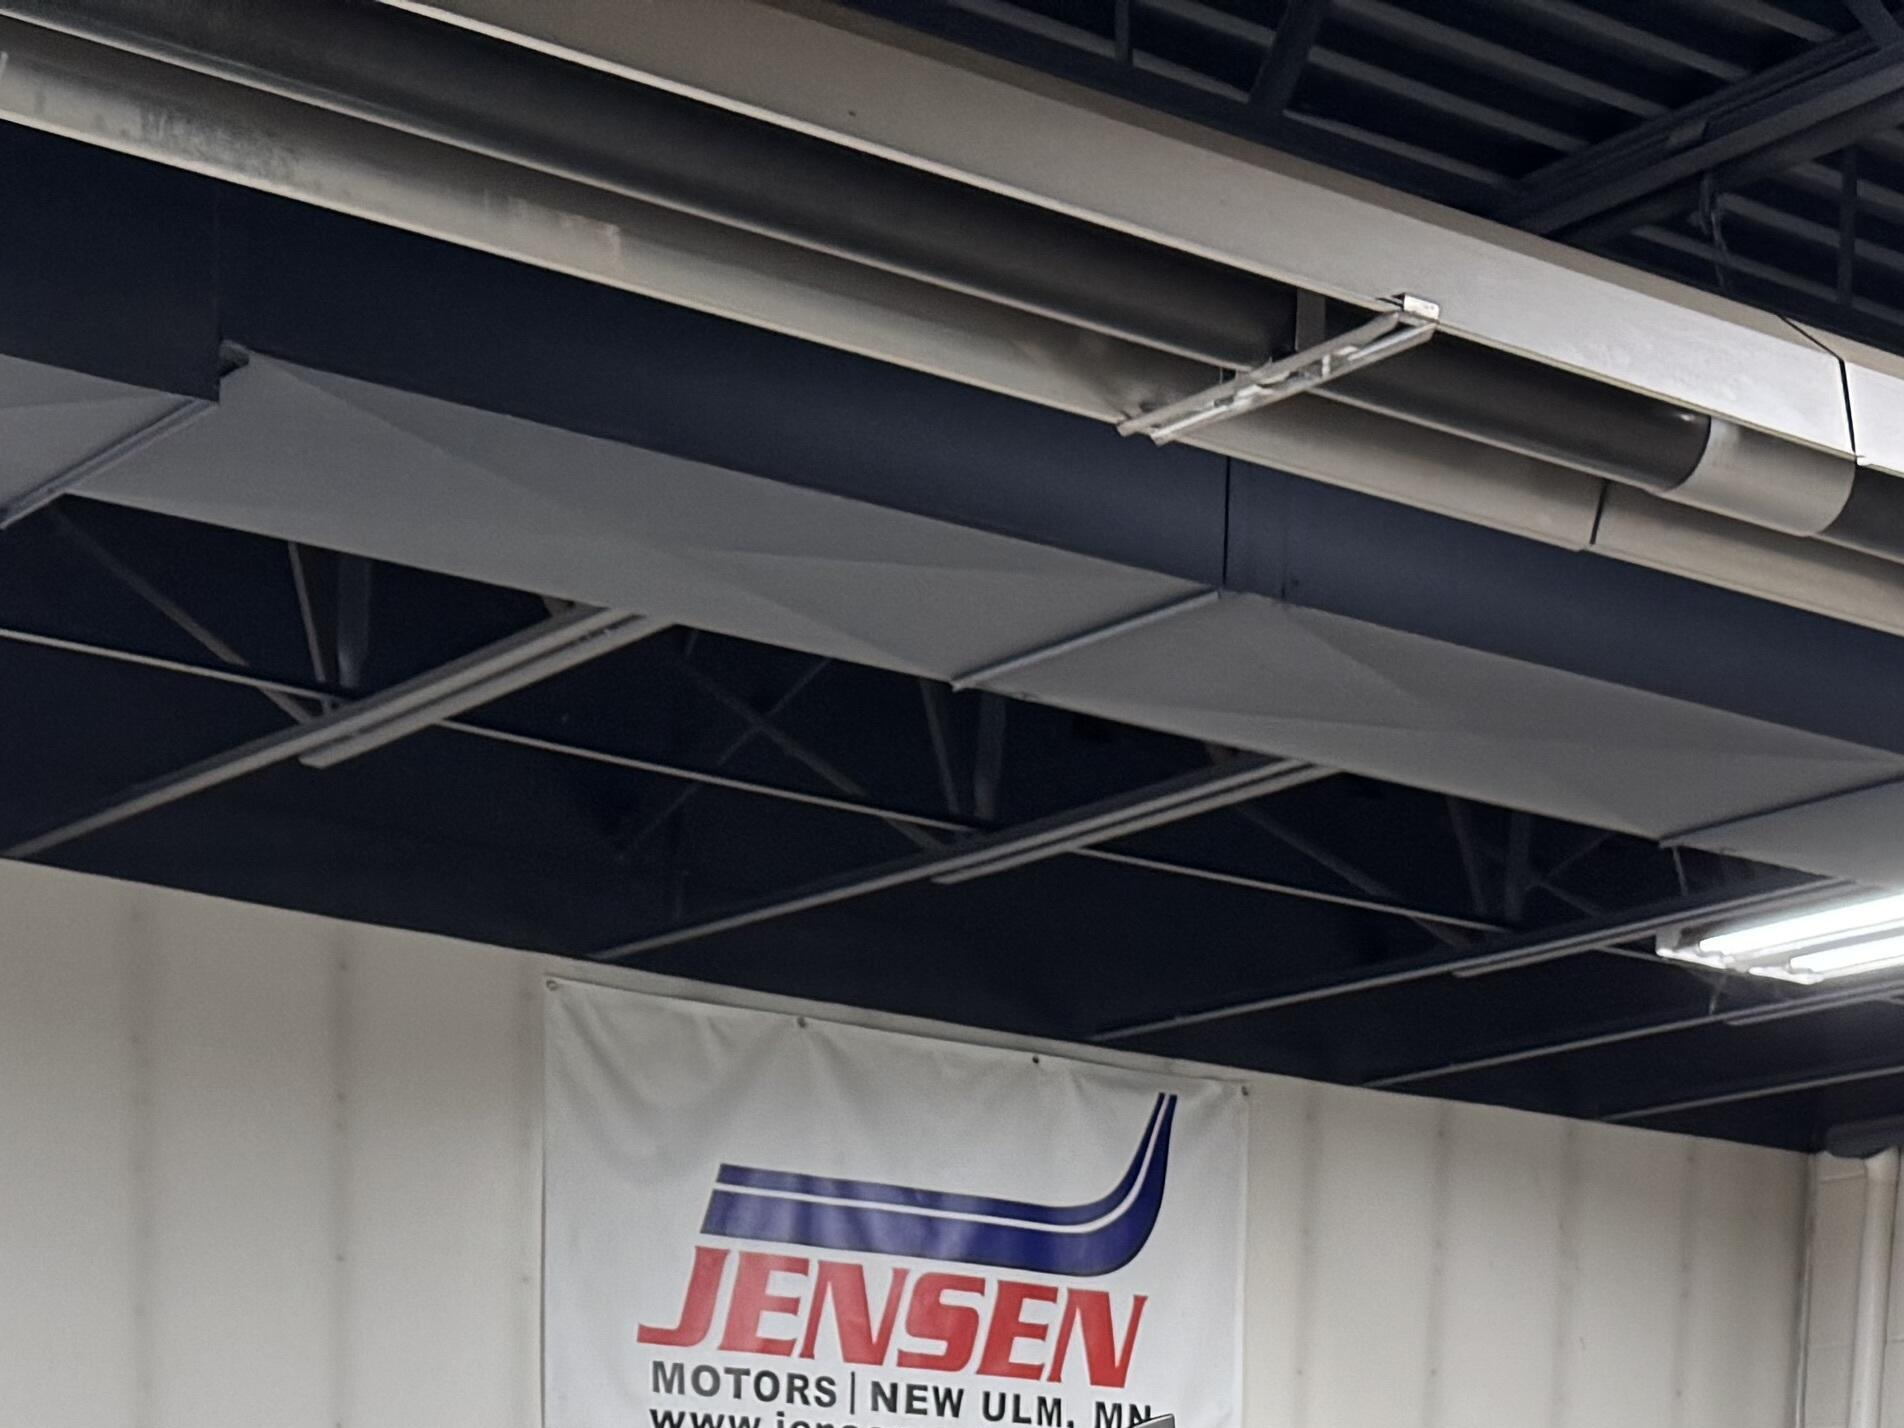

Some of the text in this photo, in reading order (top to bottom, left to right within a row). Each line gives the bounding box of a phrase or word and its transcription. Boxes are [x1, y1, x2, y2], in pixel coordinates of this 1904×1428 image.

[637, 1246, 1148, 1389] JENSEN
[652, 1360, 837, 1408] MOTORS
[870, 1380, 964, 1419] NEW
